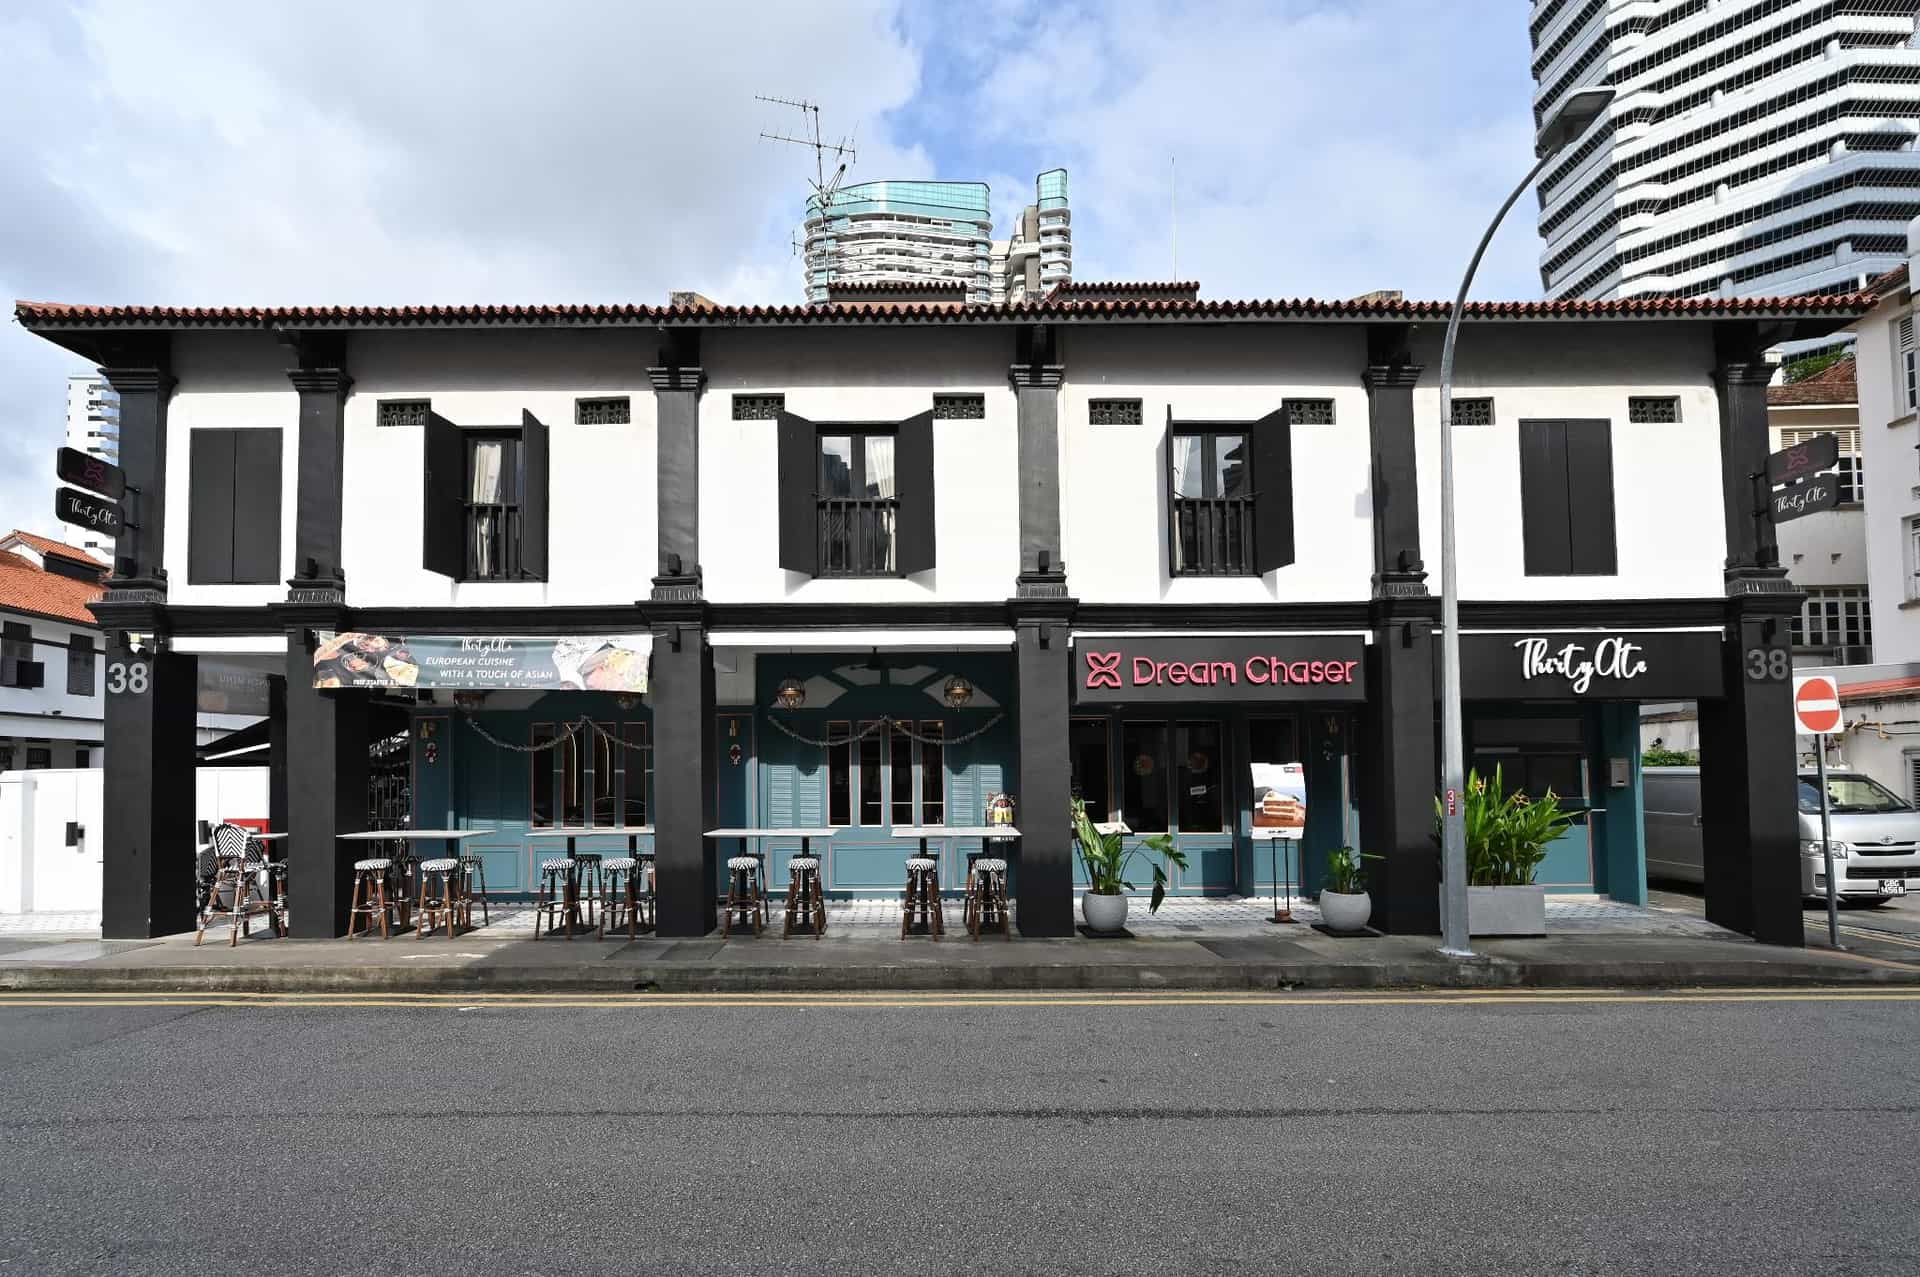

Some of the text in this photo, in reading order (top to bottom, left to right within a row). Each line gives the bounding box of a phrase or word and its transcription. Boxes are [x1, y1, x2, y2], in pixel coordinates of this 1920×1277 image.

[425, 656, 516, 666] EUROPEAN CUISINE
[439, 669, 553, 679] WITH A TOUCH OF ASIAN
[1133, 656, 1358, 684] Dream Chaser
[1513, 637, 1595, 694] Thirty
[1747, 649, 1789, 680] 38
[107, 662, 148, 694] 38
